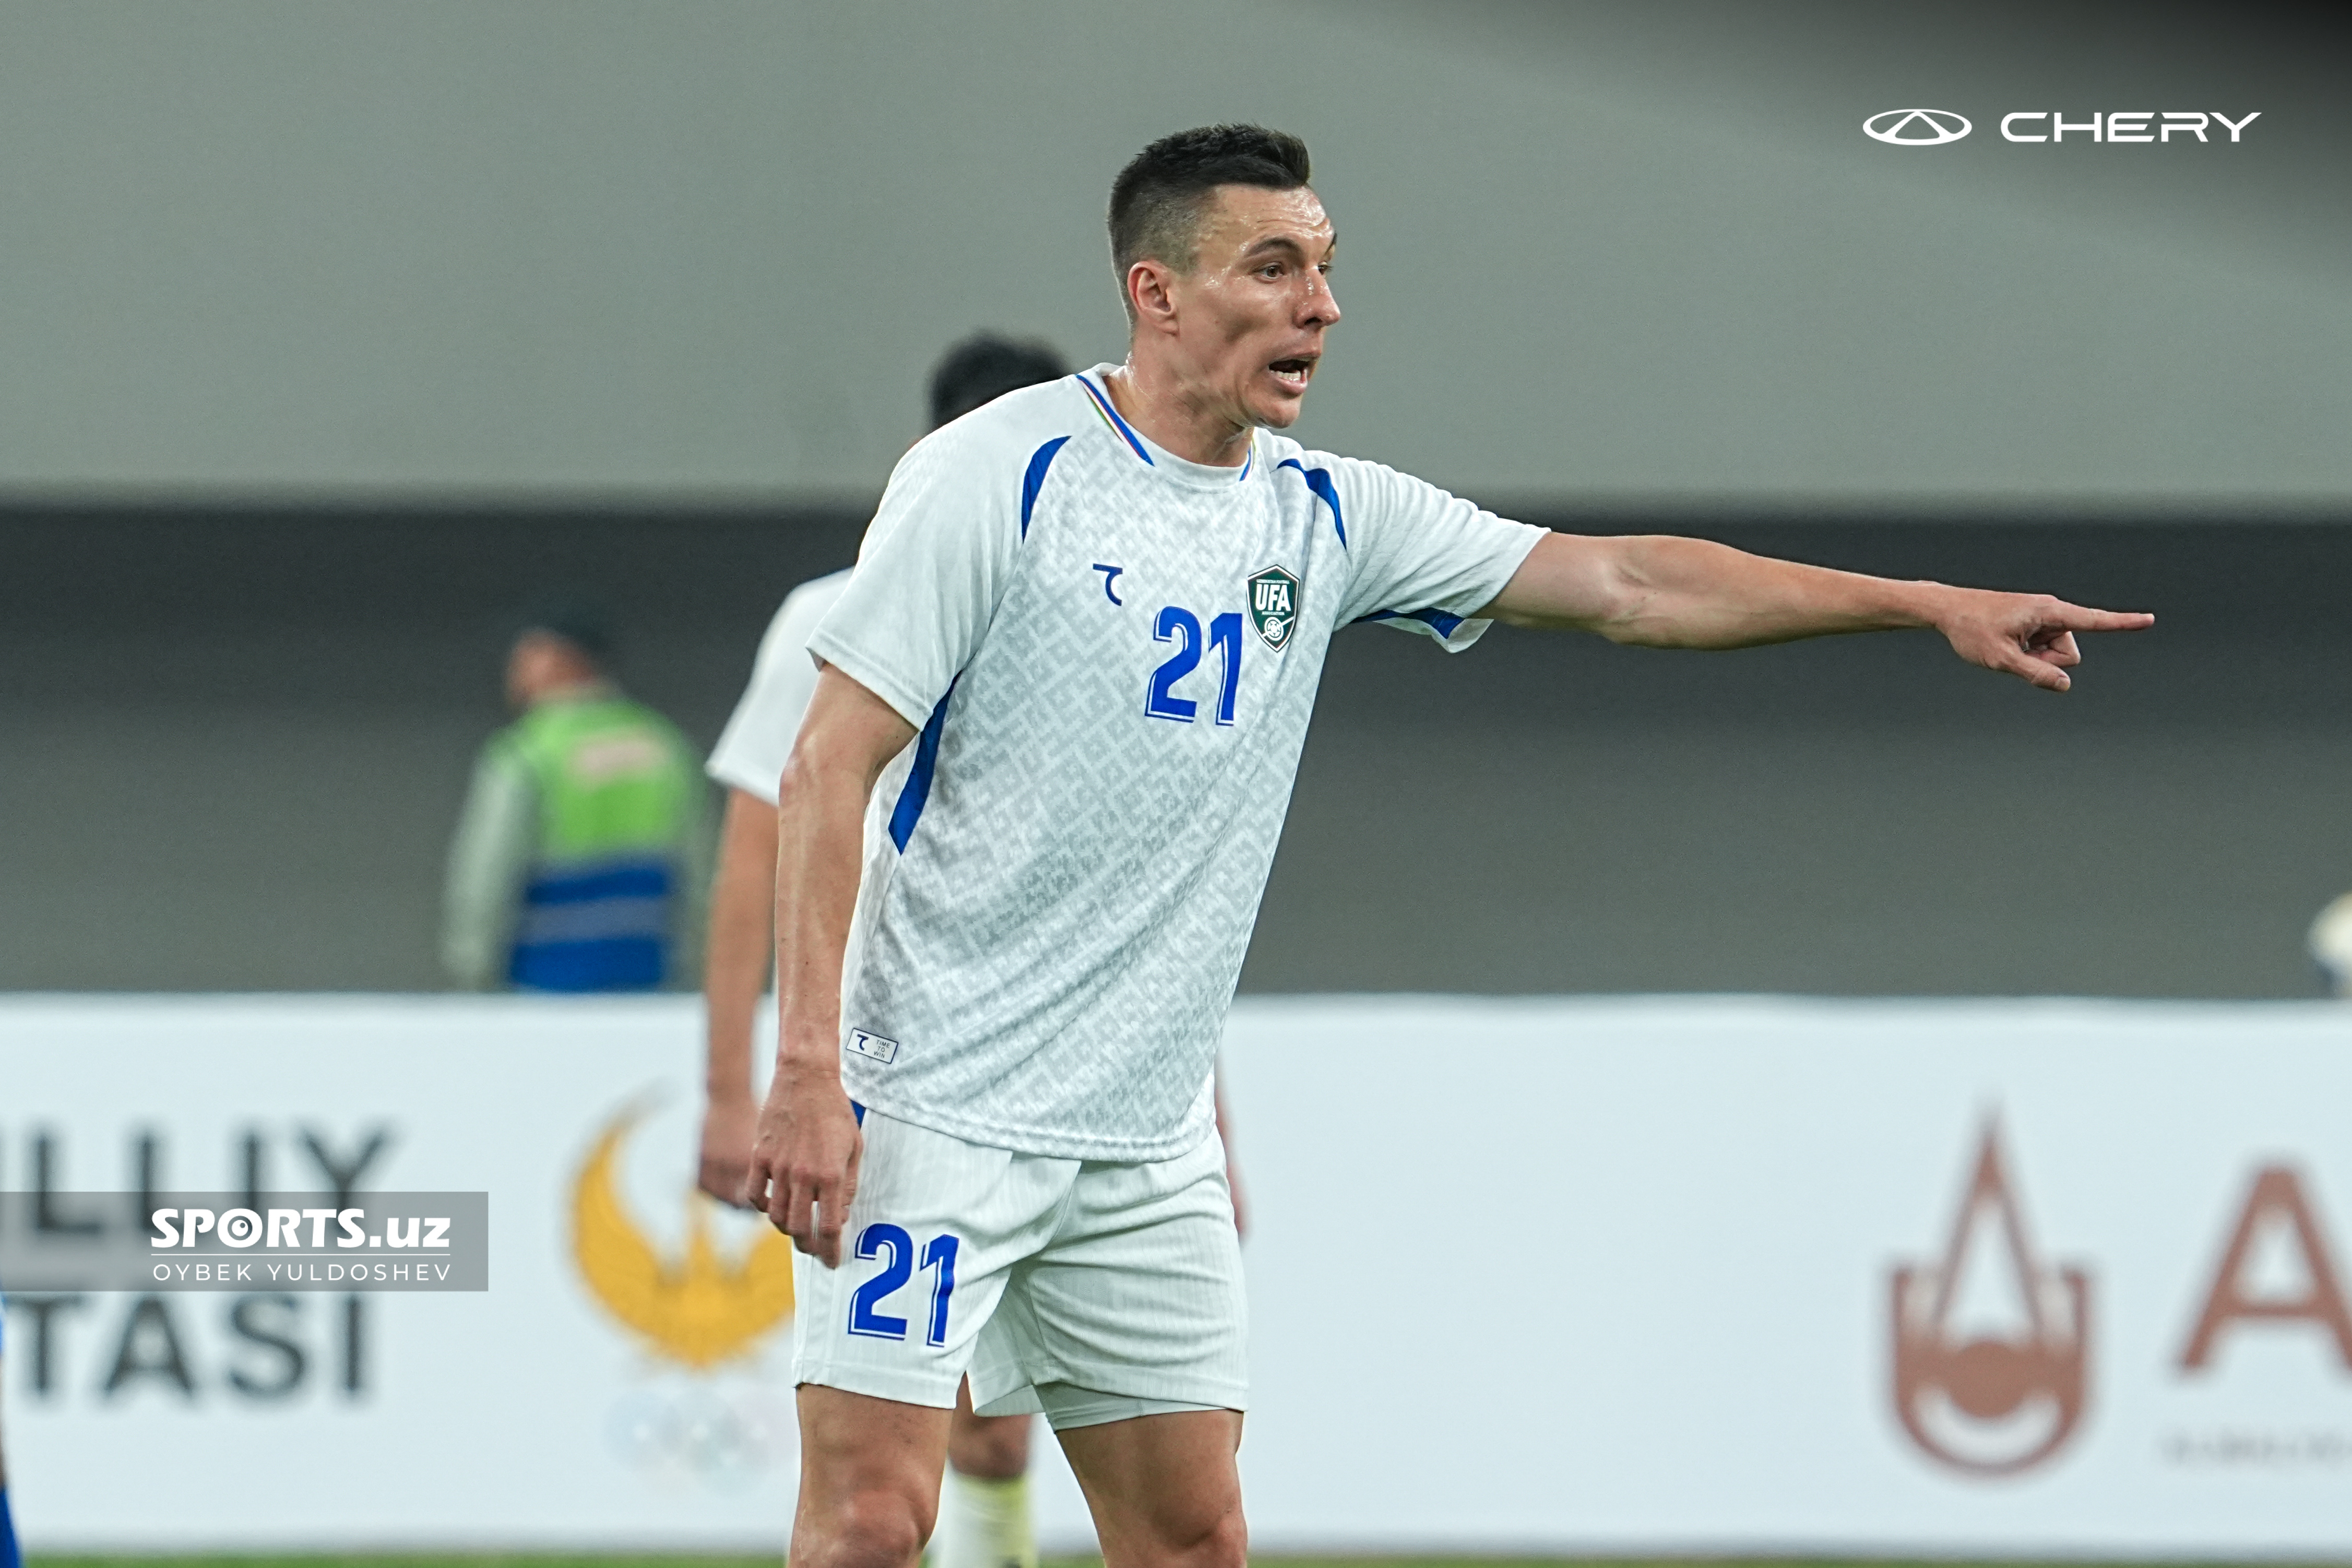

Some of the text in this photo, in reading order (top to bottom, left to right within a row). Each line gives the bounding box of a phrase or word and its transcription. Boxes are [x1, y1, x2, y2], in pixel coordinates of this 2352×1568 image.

[1255, 584, 1291, 611] UFA
[1145, 606, 1242, 726] 21
[876, 1039, 891, 1049] TIME
[848, 1223, 959, 1348] 21
[0, 1287, 368, 1401] TASI
